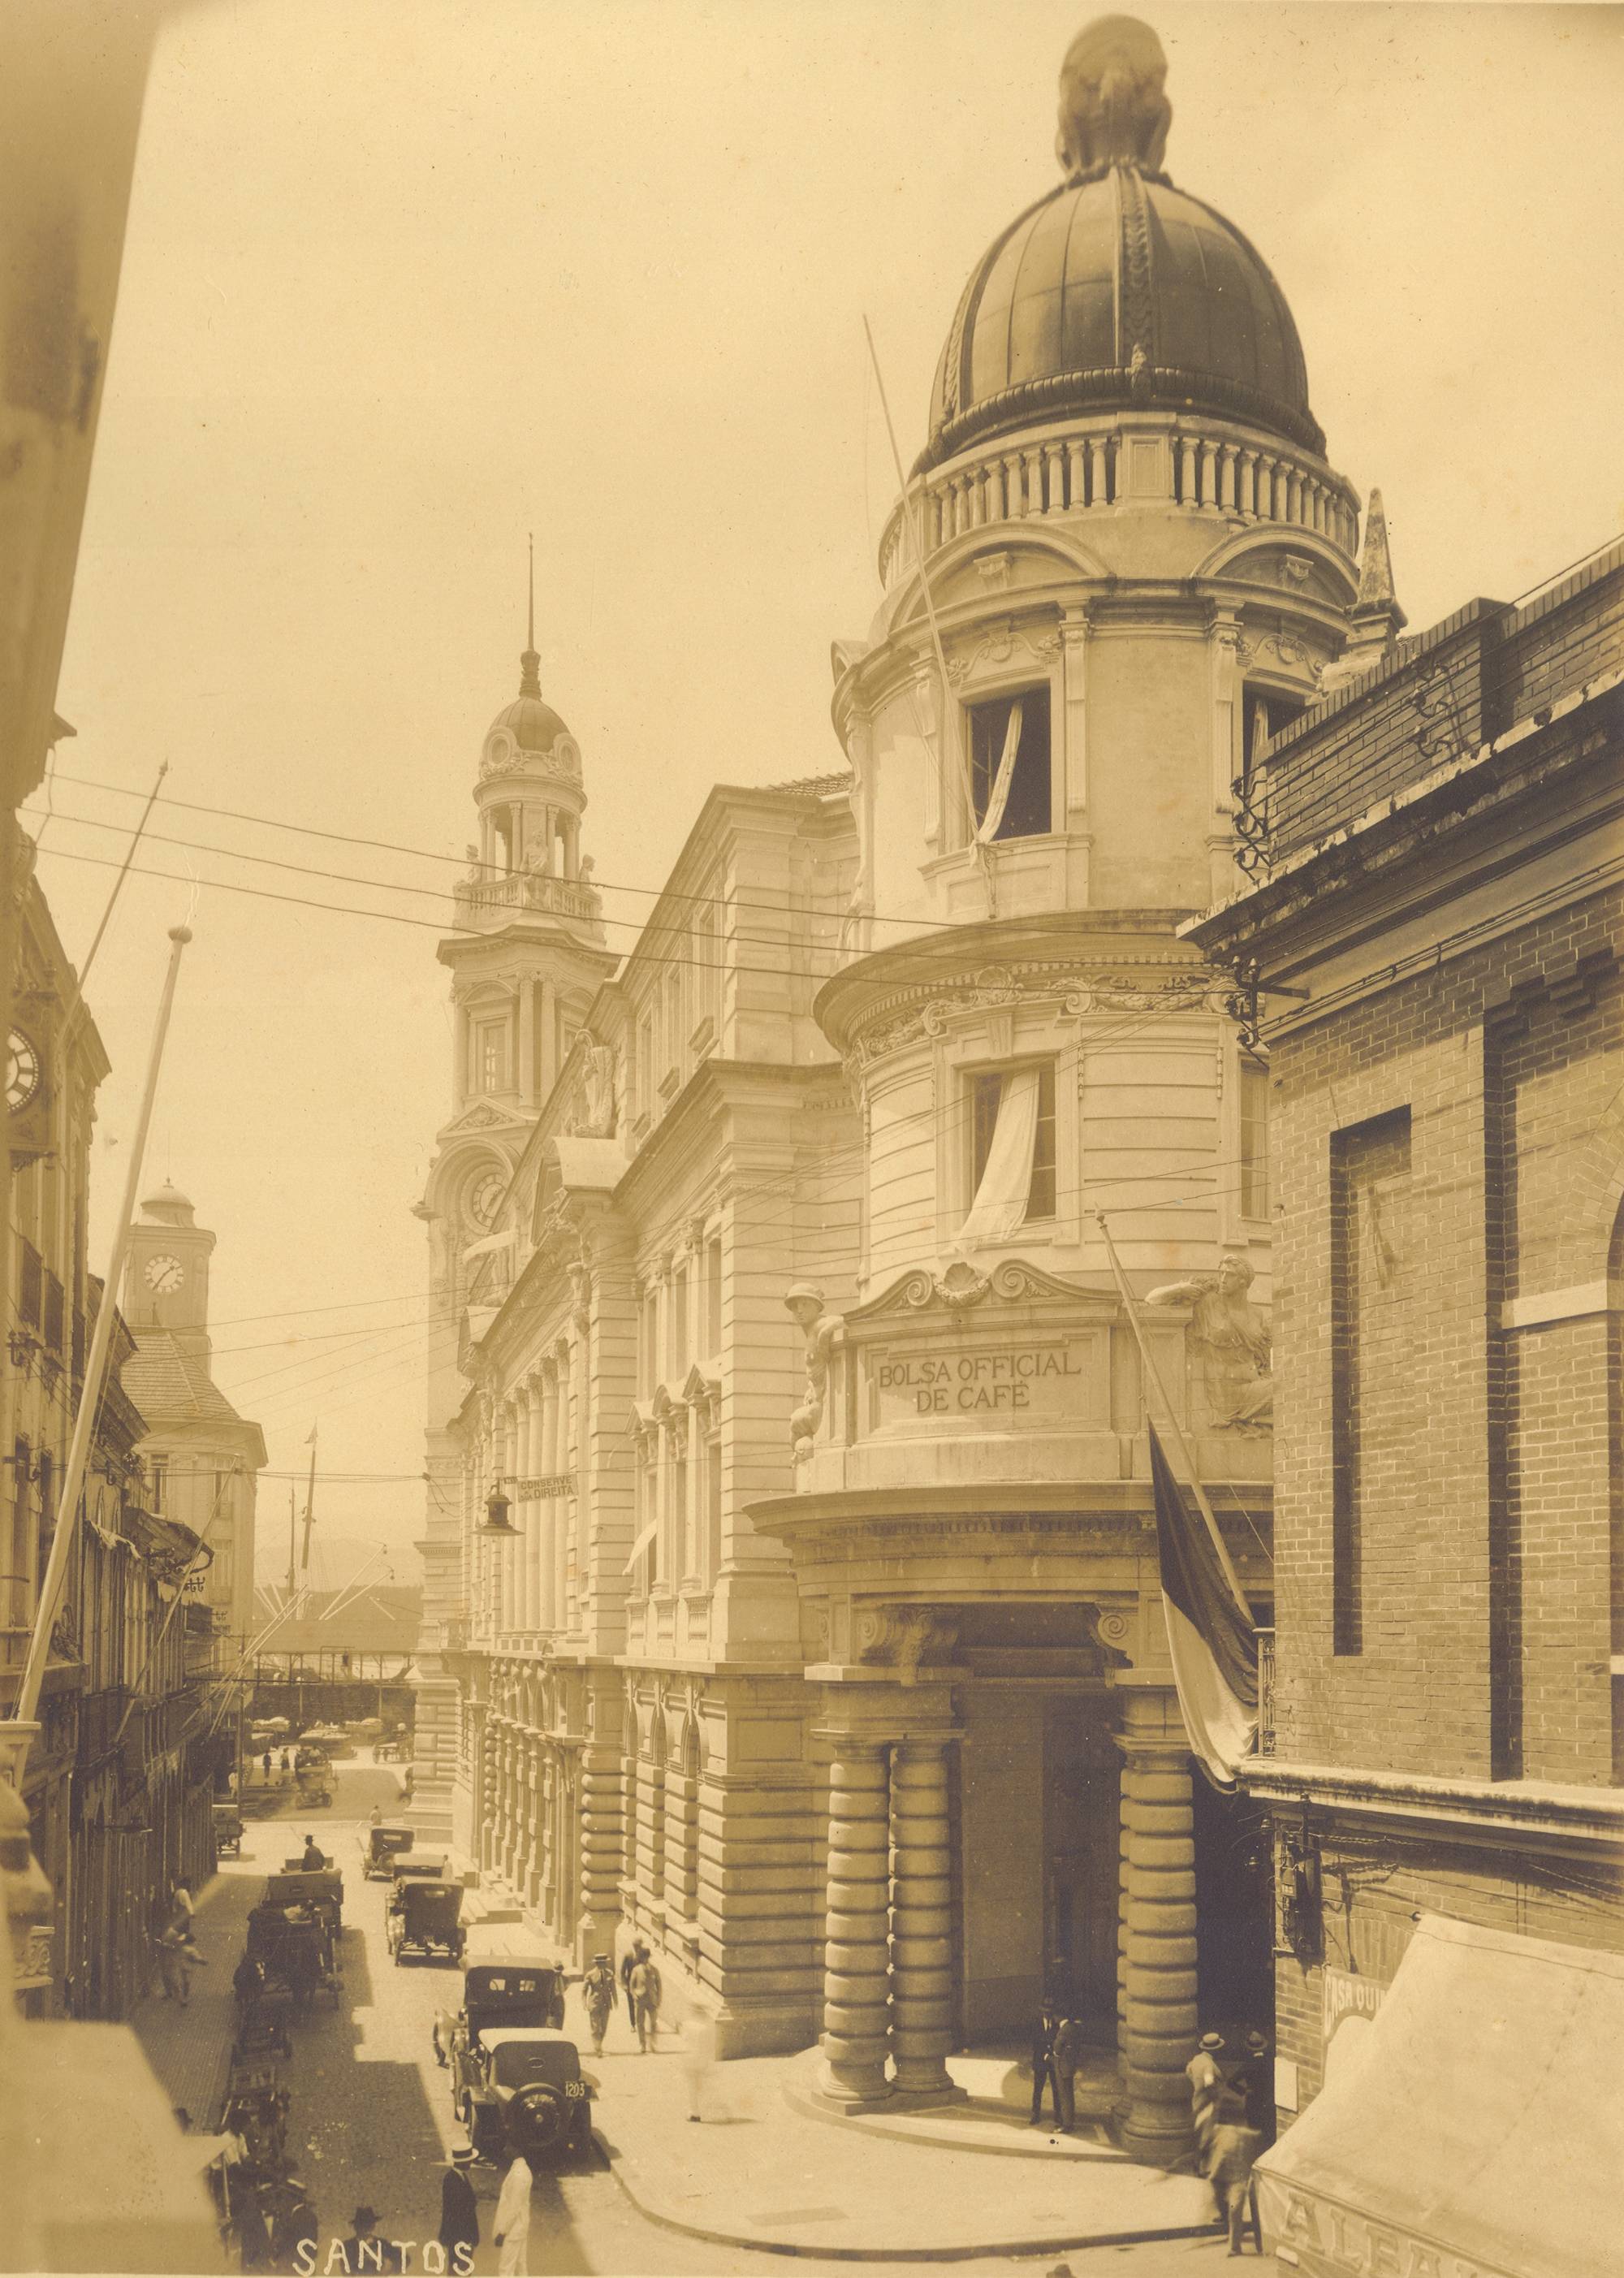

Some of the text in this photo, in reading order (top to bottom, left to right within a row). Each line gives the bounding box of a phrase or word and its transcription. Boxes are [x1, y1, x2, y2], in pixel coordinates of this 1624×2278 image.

[879, 1351, 1082, 1388] BOLSA OFFICIAL
[916, 1388, 949, 1413] DE
[520, 1475, 572, 1489] CONSERVE
[534, 1485, 573, 1500] DIREITA
[1324, 1974, 1353, 2037] CASA
